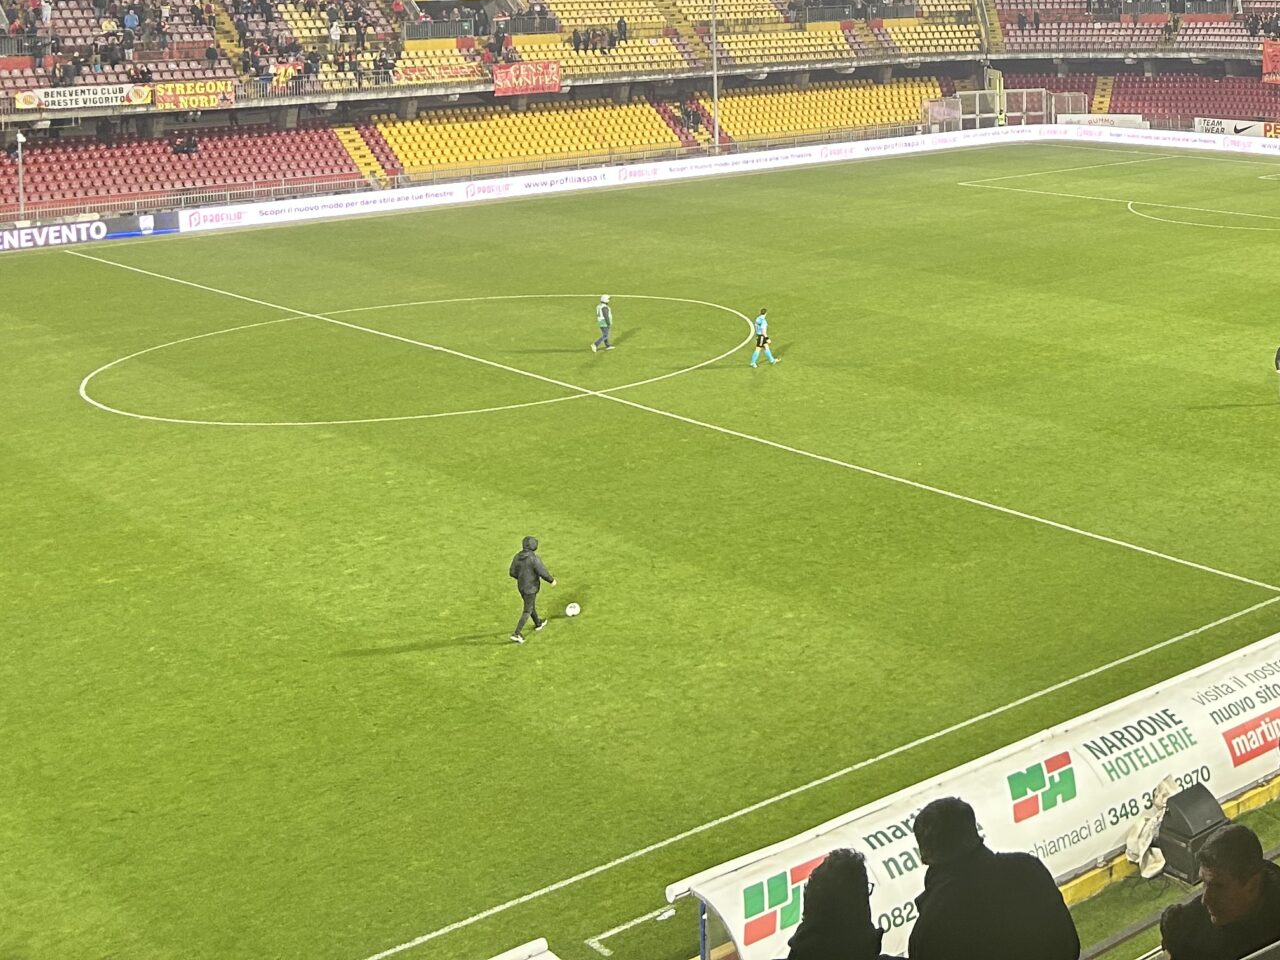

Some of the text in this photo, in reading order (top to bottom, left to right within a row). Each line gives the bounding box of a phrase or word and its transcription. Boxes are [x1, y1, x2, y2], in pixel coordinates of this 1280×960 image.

[511, 64, 544, 75] GENS
[156, 80, 233, 96] STREGONI
[495, 74, 560, 89] SAMNITES
[44, 86, 125, 98] BENEVENTO CLUB
[44, 96, 125, 107] ORESTE VIGORITO
[179, 95, 218, 108] NORD
[1202, 119, 1223, 127] TEAM
[1204, 127, 1225, 135] WEAR
[524, 172, 606, 189] www.profiliaspa.it
[259, 208, 286, 217] Scopri
[294, 204, 320, 214] nuovo
[345, 201, 358, 209] per
[360, 198, 377, 206] dare
[0, 221, 107, 251] NEVENTO
[1191, 681, 1234, 706] visita
[1229, 676, 1244, 690] il
[1209, 695, 1255, 726] nuovo
[1083, 708, 1184, 760] NARDONE
[1101, 726, 1198, 782] HOTELLERIE
[1093, 812, 1107, 833] al
[1107, 798, 1140, 826] 348
[1174, 765, 1211, 792] 3970
